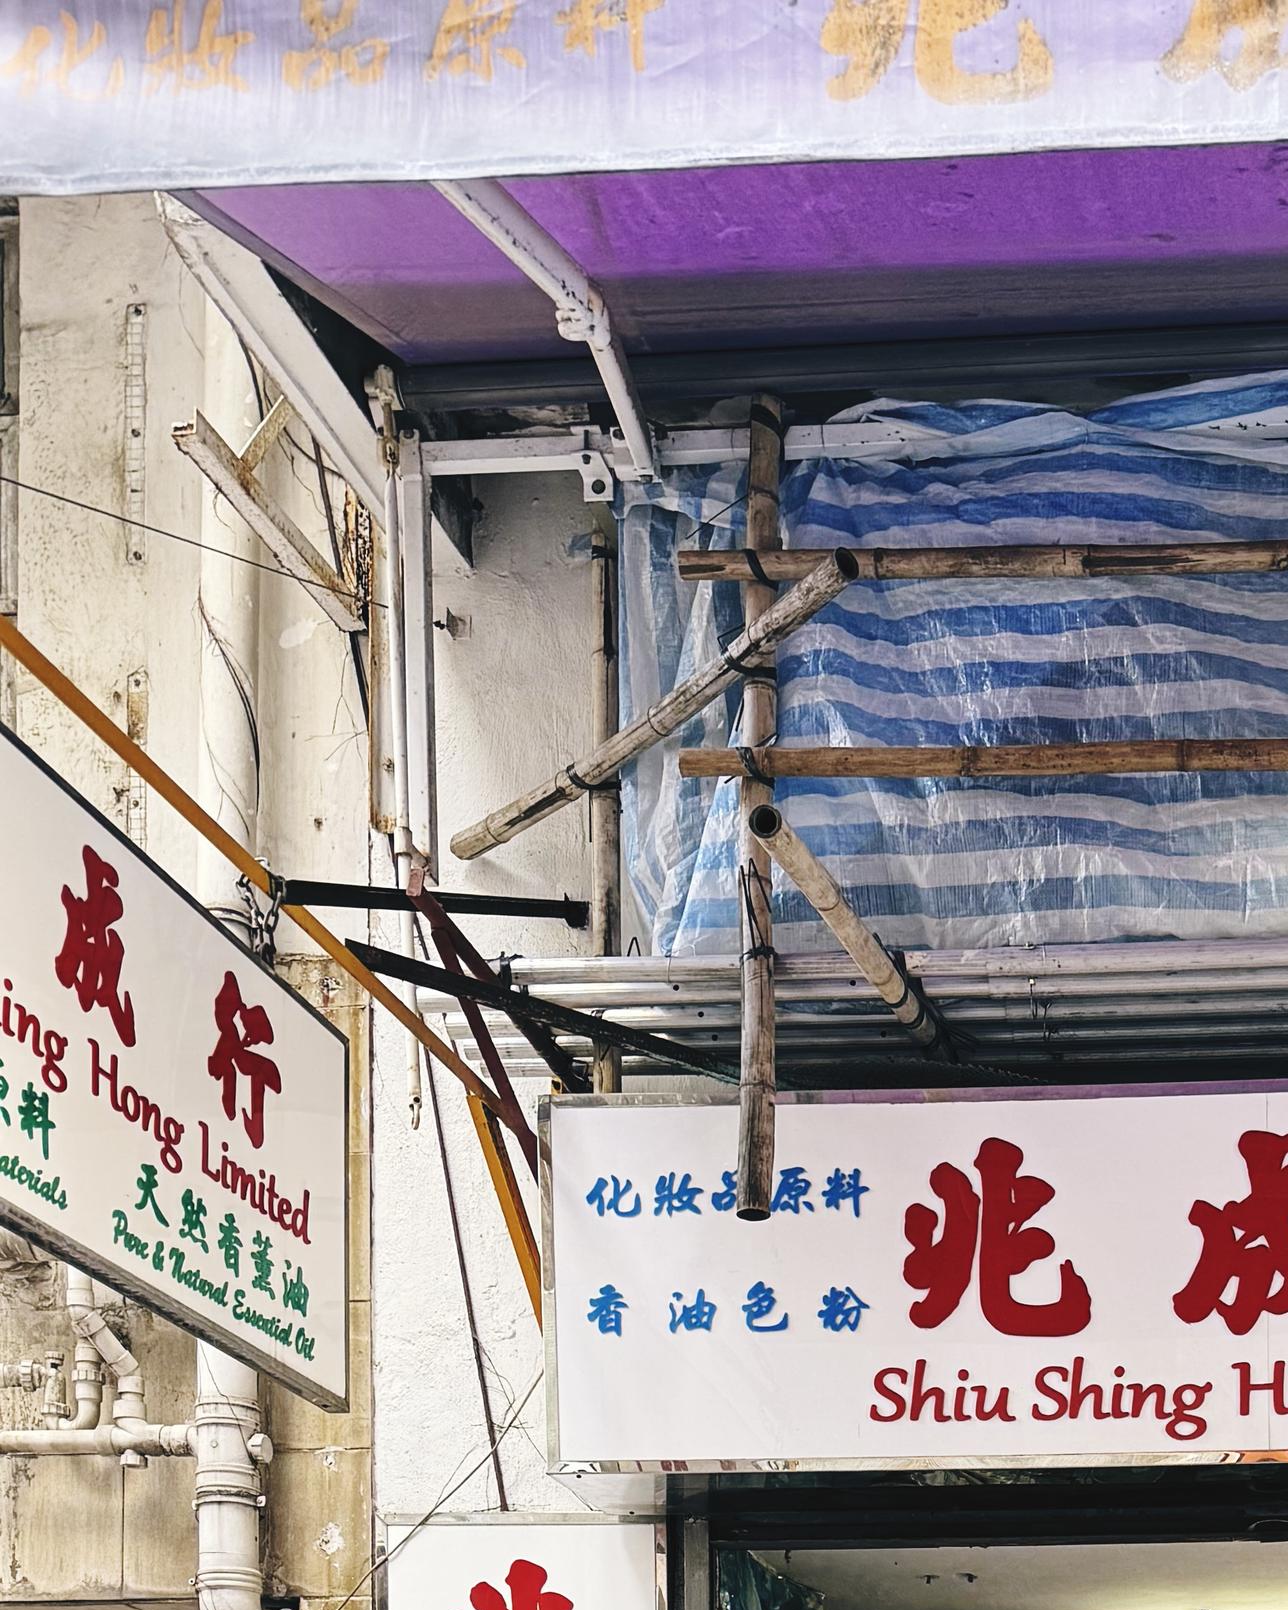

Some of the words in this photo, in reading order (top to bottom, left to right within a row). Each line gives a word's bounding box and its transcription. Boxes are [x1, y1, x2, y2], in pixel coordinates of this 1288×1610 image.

[87, 1038, 184, 1174] Hong
[198, 1120, 311, 1244] Limited
[112, 1209, 149, 1259] Pure
[152, 1241, 164, 1272] &
[169, 1247, 229, 1308] Natural
[232, 1288, 293, 1348] Essential
[295, 1327, 316, 1362] Oil
[135, 1163, 310, 1317] 天然香薰油
[586, 1281, 870, 1336] 香油色粉
[870, 1358, 1016, 1422] Shiu
[1032, 1356, 1213, 1441] Shing
